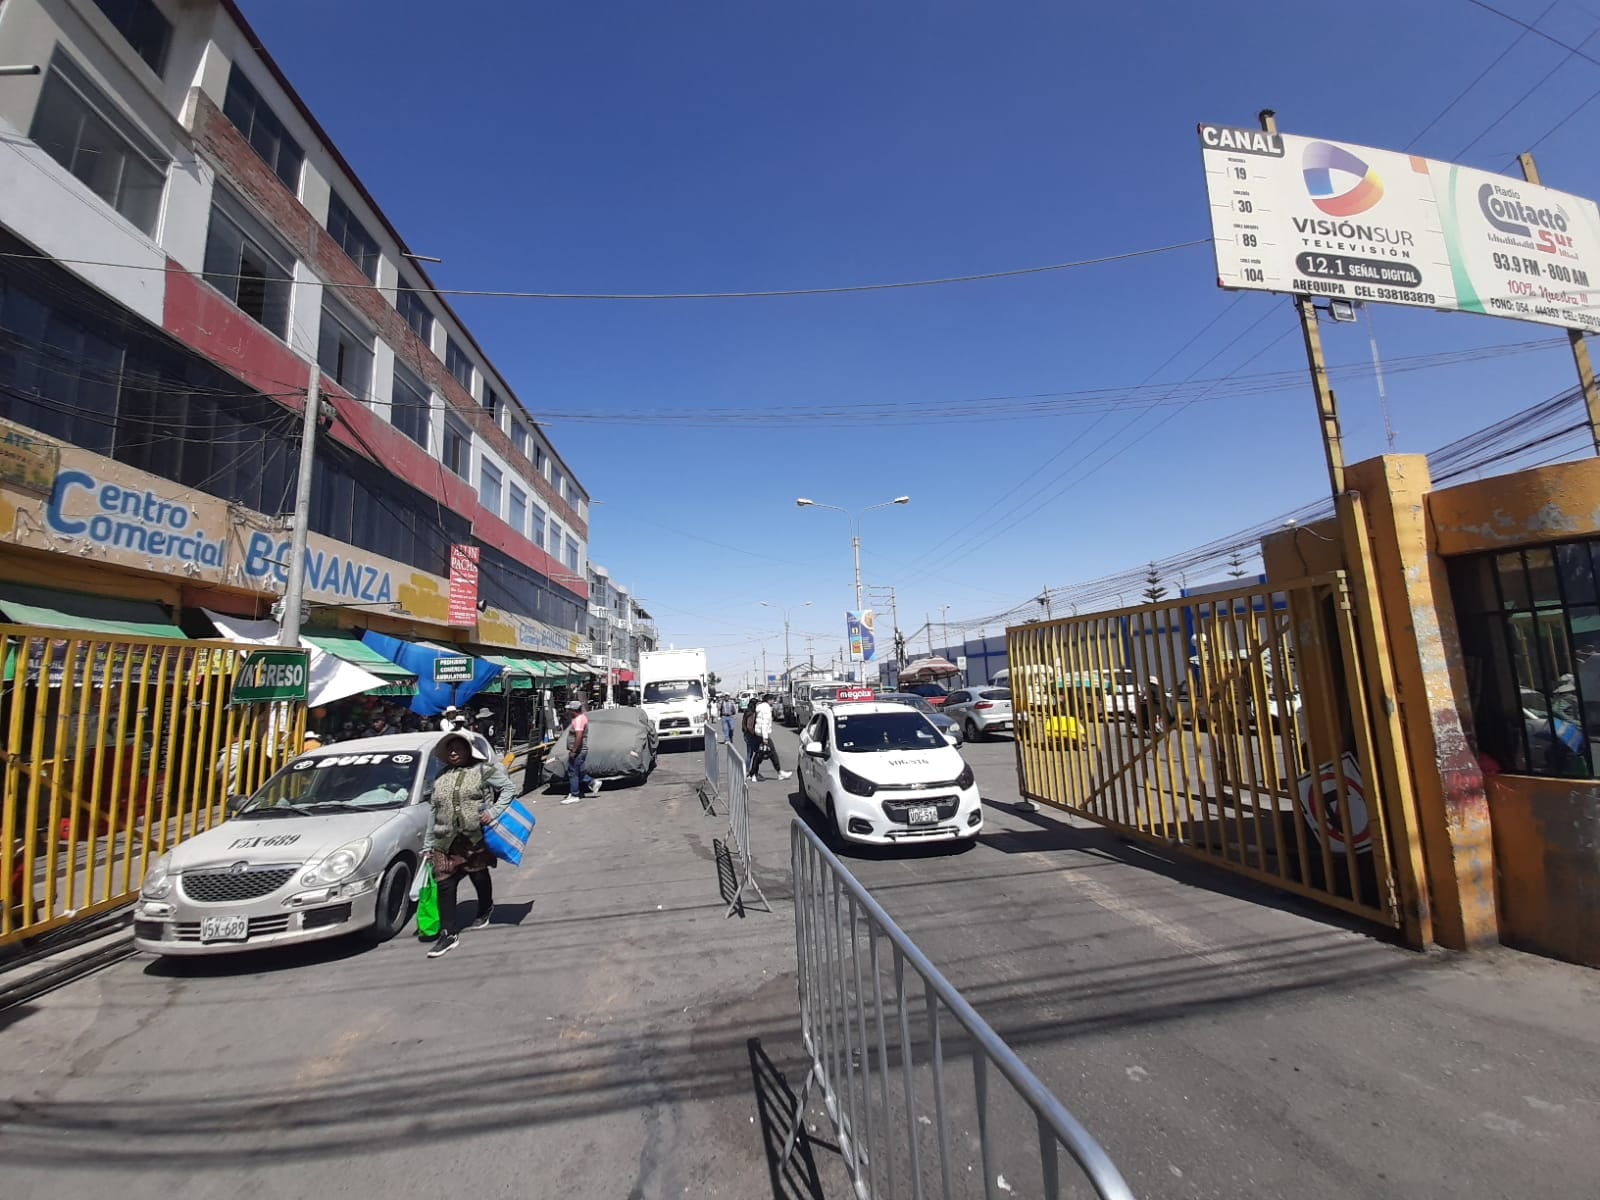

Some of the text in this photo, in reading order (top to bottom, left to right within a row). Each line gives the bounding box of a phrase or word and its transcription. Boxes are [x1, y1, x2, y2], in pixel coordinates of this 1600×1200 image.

[1202, 127, 1281, 153] CANAL
[1234, 167, 1247, 180] 19
[1494, 185, 1521, 200] Radio
[1238, 200, 1253, 213] 30
[1478, 183, 1567, 237] Contacto
[1242, 233, 1257, 247] 89
[1302, 238, 1411, 259] TELEVISIÓN
[1536, 229, 1573, 254] Sur
[1244, 268, 1264, 282] 104
[1305, 256, 1417, 284] 12.1 SEÑAL DIGITAL
[1493, 252, 1521, 273] 93.9
[1522, 258, 1541, 277] FM
[1548, 263, 1571, 283] 800
[1571, 269, 1590, 287] AM
[1292, 279, 1346, 295] AREQUIPA
[1354, 285, 1375, 298] CEL:
[1507, 279, 1536, 297] 100%
[1490, 298, 1514, 311] FONO:
[47, 470, 189, 535] Centro
[244, 531, 392, 602] BONANZA
[237, 664, 303, 687] INGRESO
[316, 754, 390, 768] DUET
[202, 920, 245, 937] V5X-689
